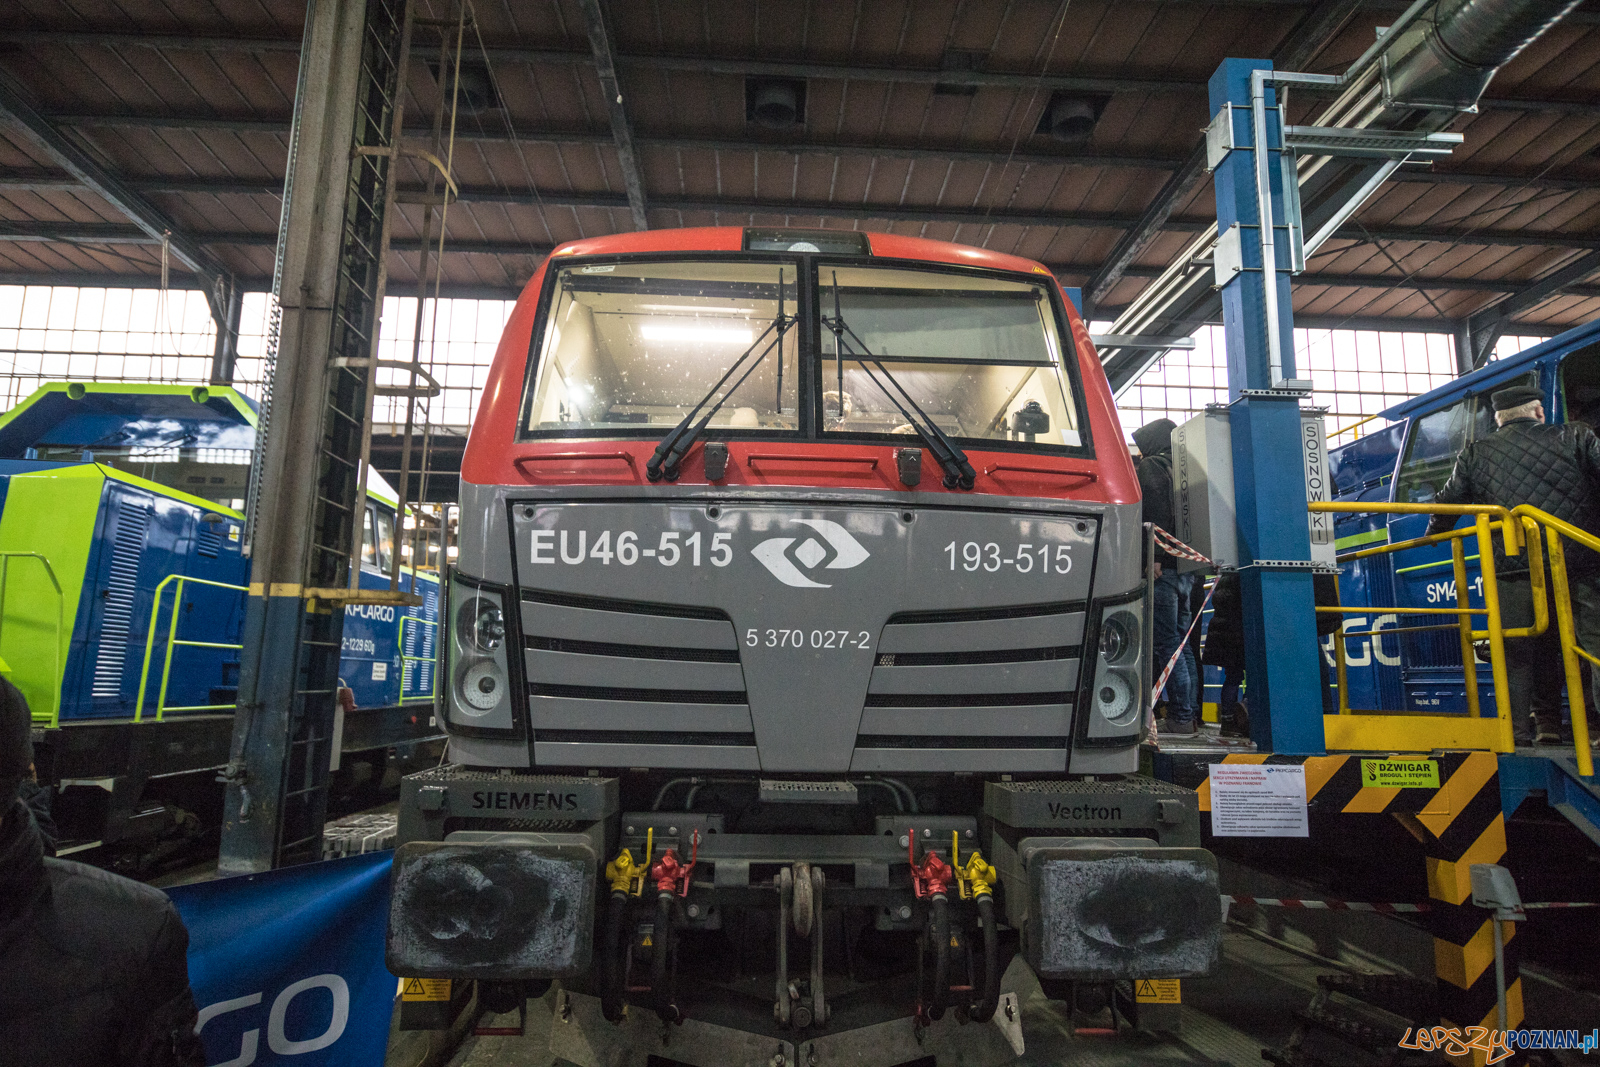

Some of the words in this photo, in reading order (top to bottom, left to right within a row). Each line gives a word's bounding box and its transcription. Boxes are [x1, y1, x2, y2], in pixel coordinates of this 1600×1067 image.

[1179, 431, 1189, 540] SOSNOWSKI
[1305, 426, 1324, 541] SOSNOWKI
[530, 529, 733, 567] EU46-515
[944, 540, 1073, 574] 193-515
[1426, 576, 1484, 603] SM4-1
[345, 604, 395, 623] KPCARGO
[341, 637, 364, 652] 2-1229
[745, 628, 759, 647] 5
[765, 629, 804, 648] 370
[810, 630, 871, 649] 027-2
[472, 791, 578, 812] SIEMENS
[1047, 802, 1122, 820] Vectron
